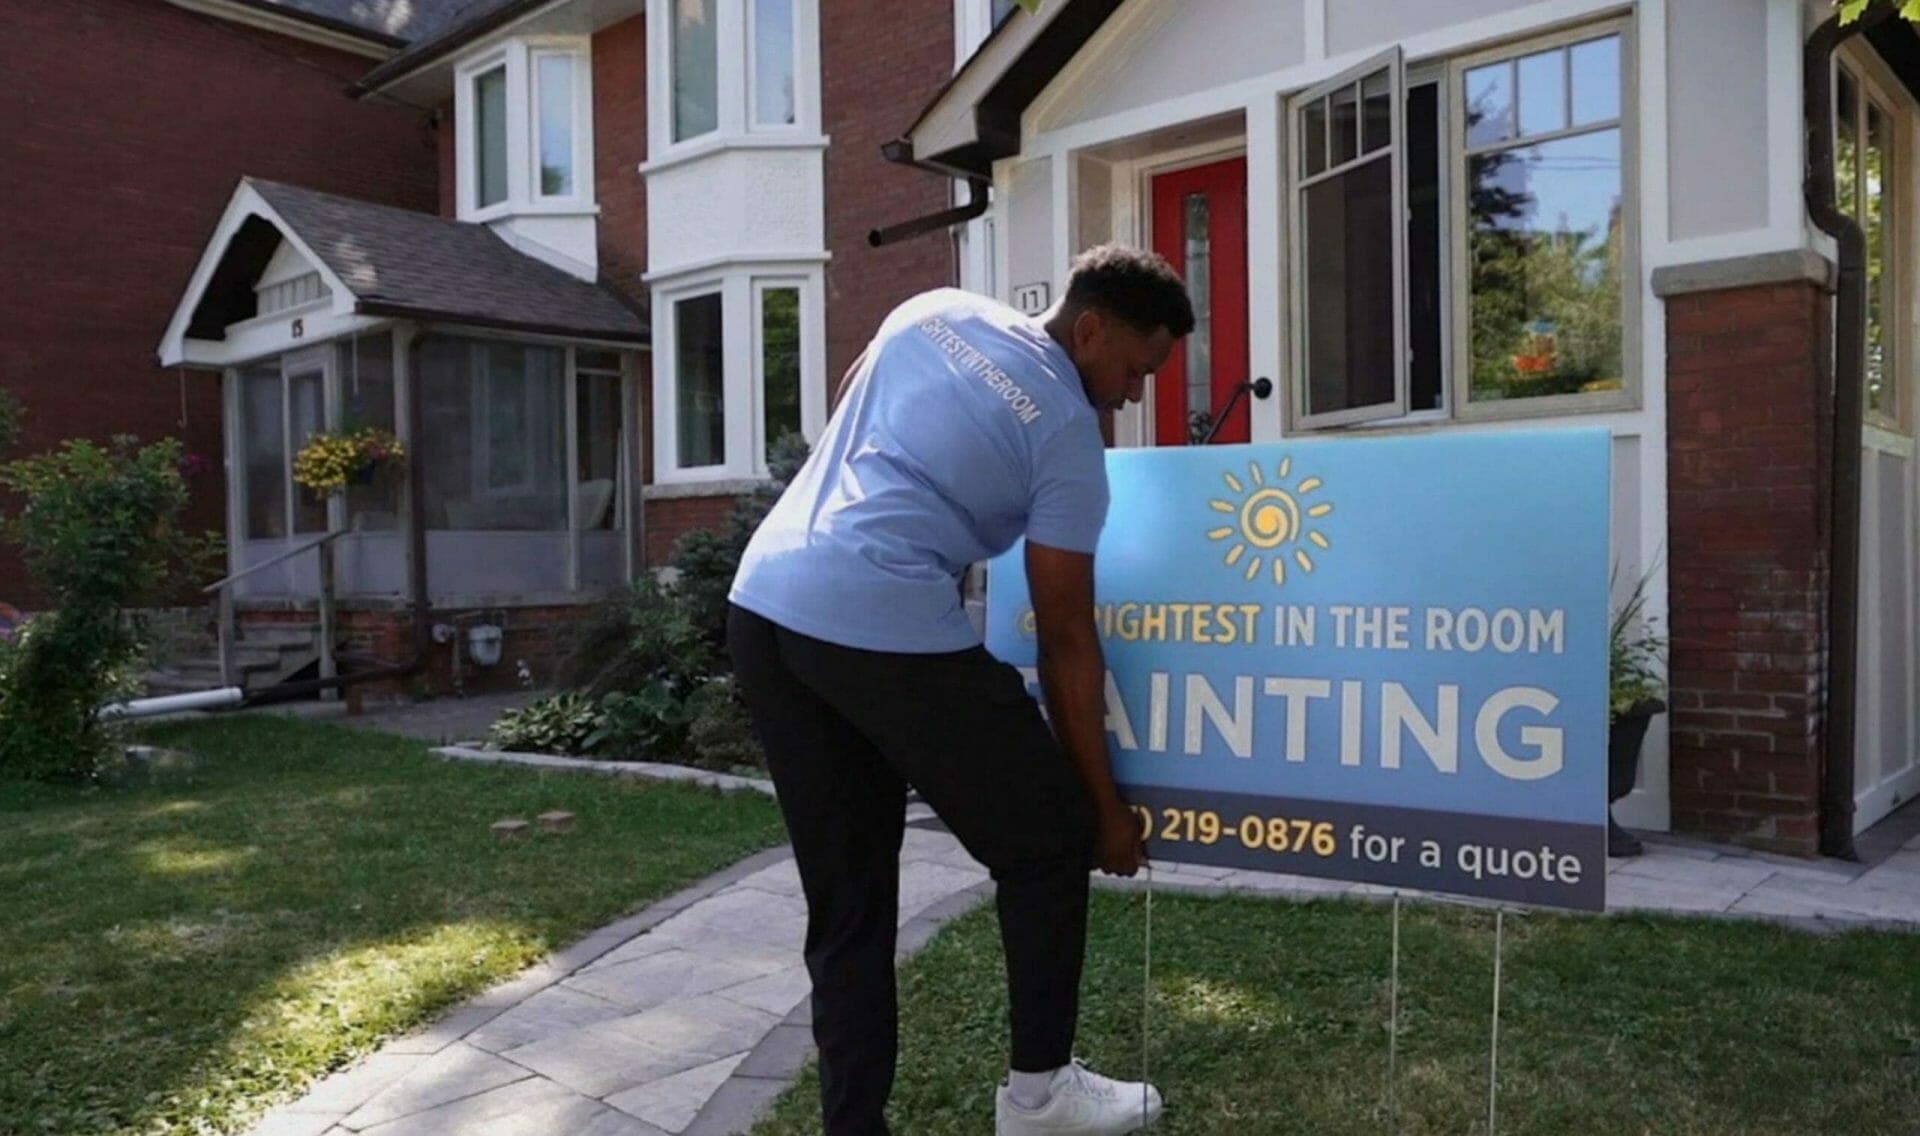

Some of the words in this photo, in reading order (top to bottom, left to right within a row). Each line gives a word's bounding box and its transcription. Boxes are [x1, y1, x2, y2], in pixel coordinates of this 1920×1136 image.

[1022, 290, 1038, 310] 17
[919, 319, 1042, 424] GHTESTINTHEROOM
[1274, 605, 1315, 647] IN
[1329, 606, 1410, 650] THE
[1425, 607, 1565, 654] ROOM
[1016, 666, 1564, 781] AINTING
[1160, 807, 1336, 856] 219-0876
[1350, 824, 1405, 864] for
[1419, 839, 1441, 869] a
[1457, 845, 1582, 884] quote
